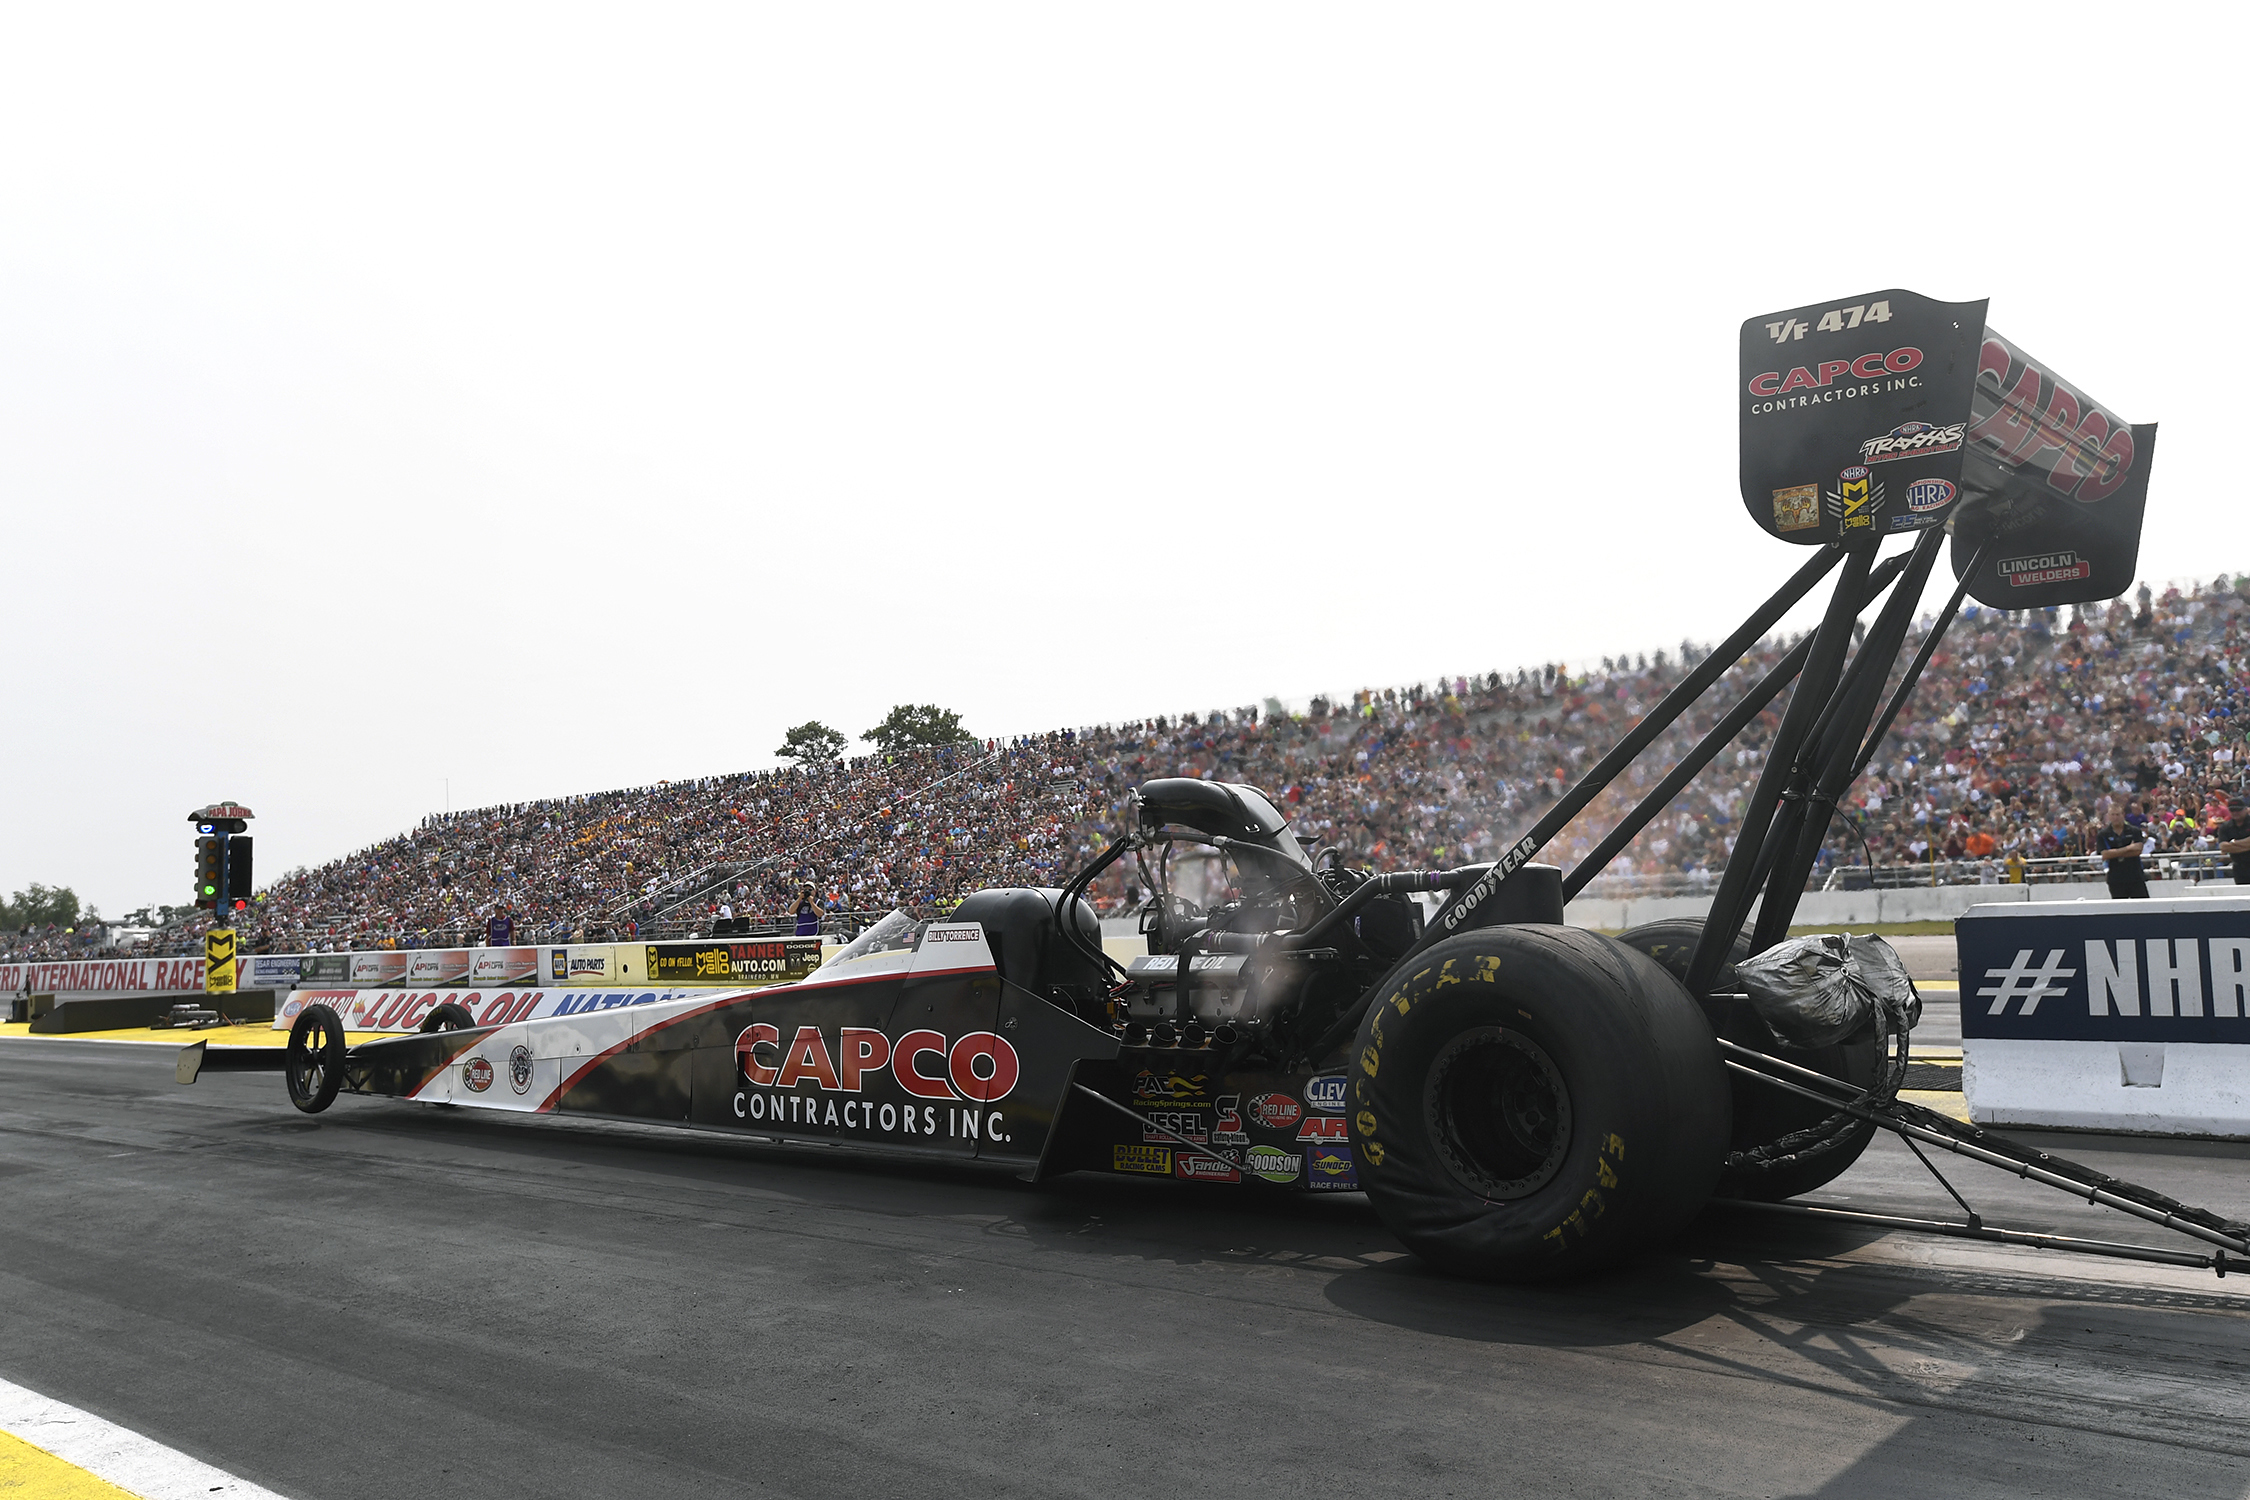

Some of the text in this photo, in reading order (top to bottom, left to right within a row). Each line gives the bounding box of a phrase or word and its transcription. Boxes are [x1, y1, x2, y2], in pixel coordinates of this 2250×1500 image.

[1765, 300, 1893, 344] T/F 474
[1748, 346, 1924, 398] CAPCO
[1751, 375, 1923, 415] CONTRACTORS INC.
[1864, 425, 1962, 456] TRAXXAS
[1843, 467, 1867, 479] NHRA
[2002, 554, 2072, 574] LINCOLN
[2018, 567, 2080, 583] WELDERS
[208, 807, 227, 818] PAPA
[1444, 836, 1538, 931] GOODYEAR
[928, 930, 979, 942] BILLY TORRENCE
[730, 943, 785, 959] TANNER
[802, 952, 820, 963] Jeep
[570, 958, 605, 970] AUTO PARTS
[731, 959, 786, 973] AUTO.COM
[1143, 957, 1175, 970] RED
[1201, 956, 1227, 970] OIL
[0, 958, 248, 991] RD INTERNATIONAL RACEY
[477, 991, 536, 1027] OIL
[734, 1022, 1020, 1103] CAPCO
[481, 1069, 491, 1080] LINE
[1132, 1074, 1175, 1095] PAC
[1133, 1098, 1212, 1109] RacingSprings.com
[1262, 1104, 1298, 1116] RED LINE
[733, 1091, 1012, 1143] CONTRACTORS INC.
[1144, 1113, 1206, 1136] JESEL
[1116, 1146, 1169, 1164] BULLET
[1247, 1153, 1300, 1172] GOODSON
[1120, 1163, 1166, 1172] RACING CAMS
[1313, 1160, 1351, 1170] SUNOCO
[1310, 1181, 1358, 1190] RACE FUELS
